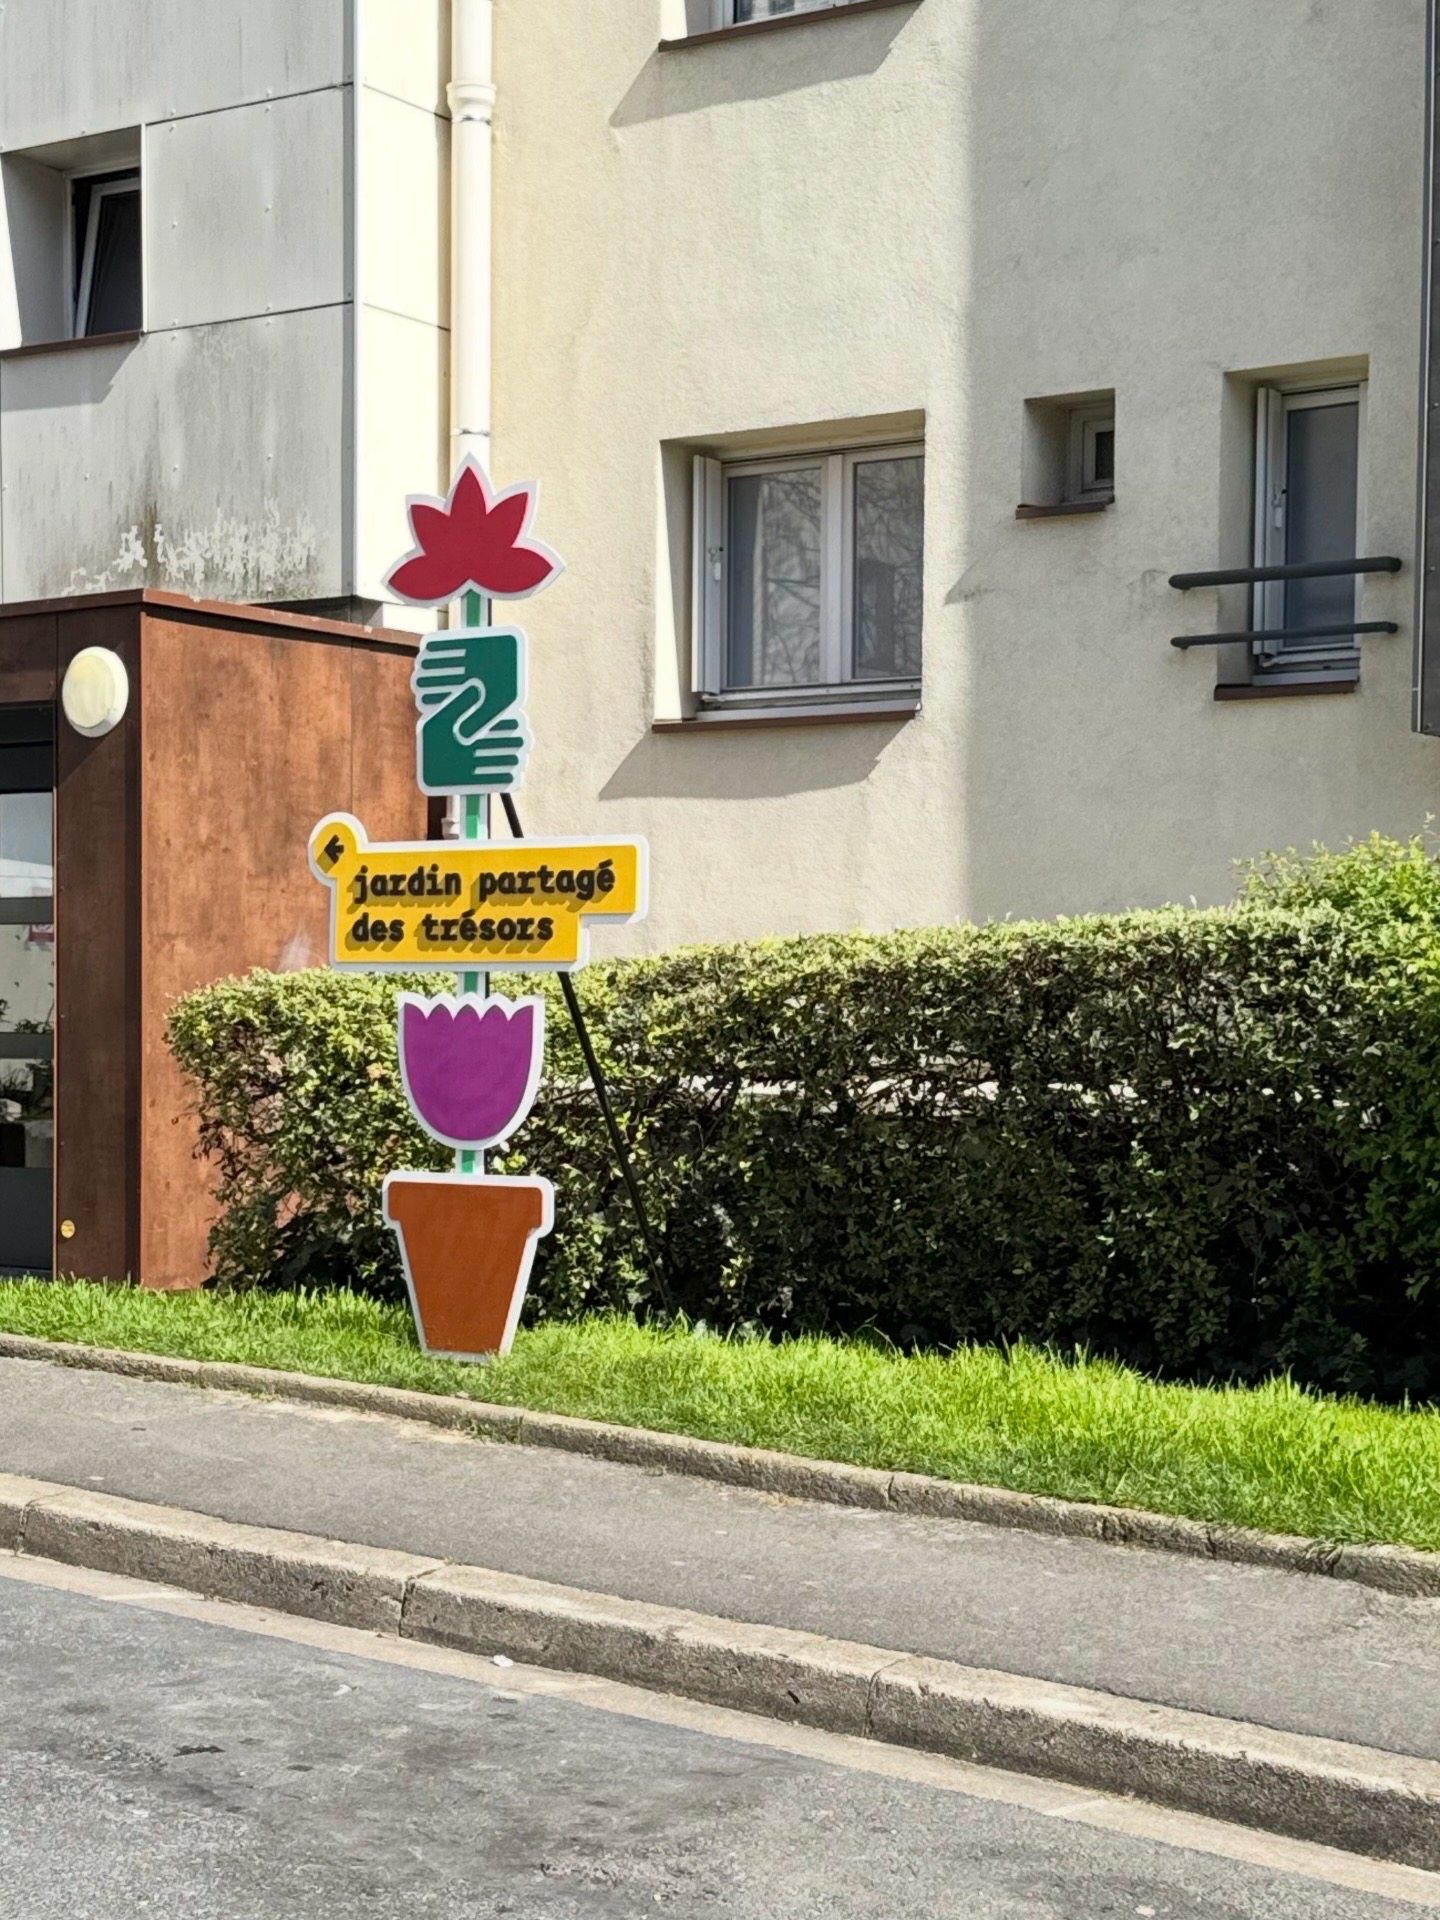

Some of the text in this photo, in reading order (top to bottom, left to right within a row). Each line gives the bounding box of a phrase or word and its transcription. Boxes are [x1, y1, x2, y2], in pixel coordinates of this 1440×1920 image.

[354, 859, 615, 904] jardin partagé
[352, 908, 554, 942] des trésors
